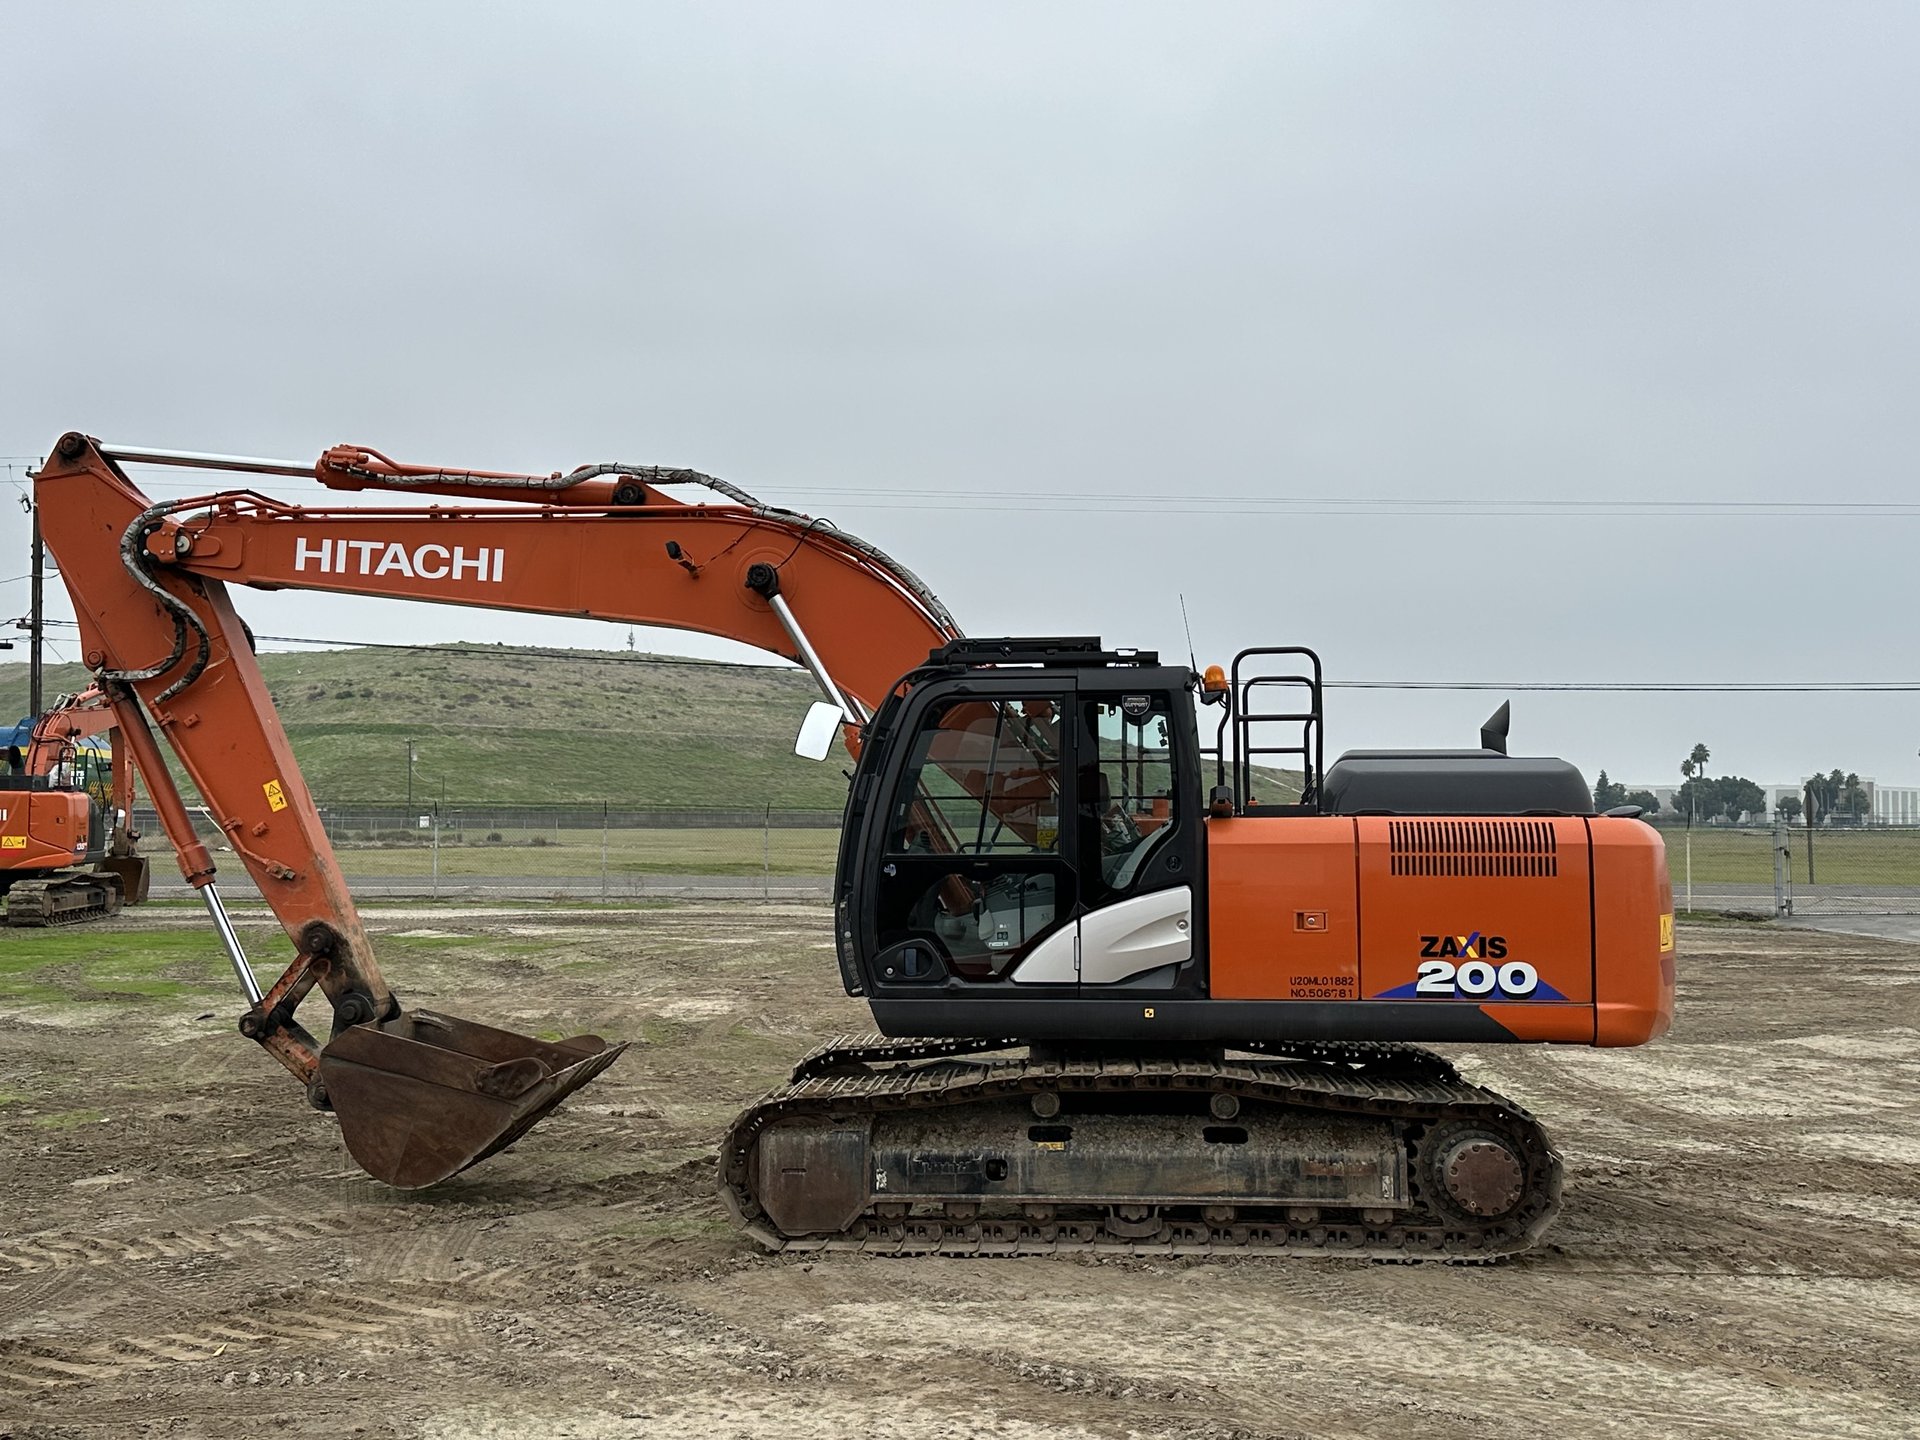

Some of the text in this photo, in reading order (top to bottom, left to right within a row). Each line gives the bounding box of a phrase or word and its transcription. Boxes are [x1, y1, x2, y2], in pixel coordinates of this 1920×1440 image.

[295, 537, 504, 582] HITACHI
[1420, 932, 1508, 959] ZAXIS
[1290, 977, 1354, 986] U20ML01882
[1416, 960, 1538, 997] 200
[1290, 988, 1353, 998] NO.506781
